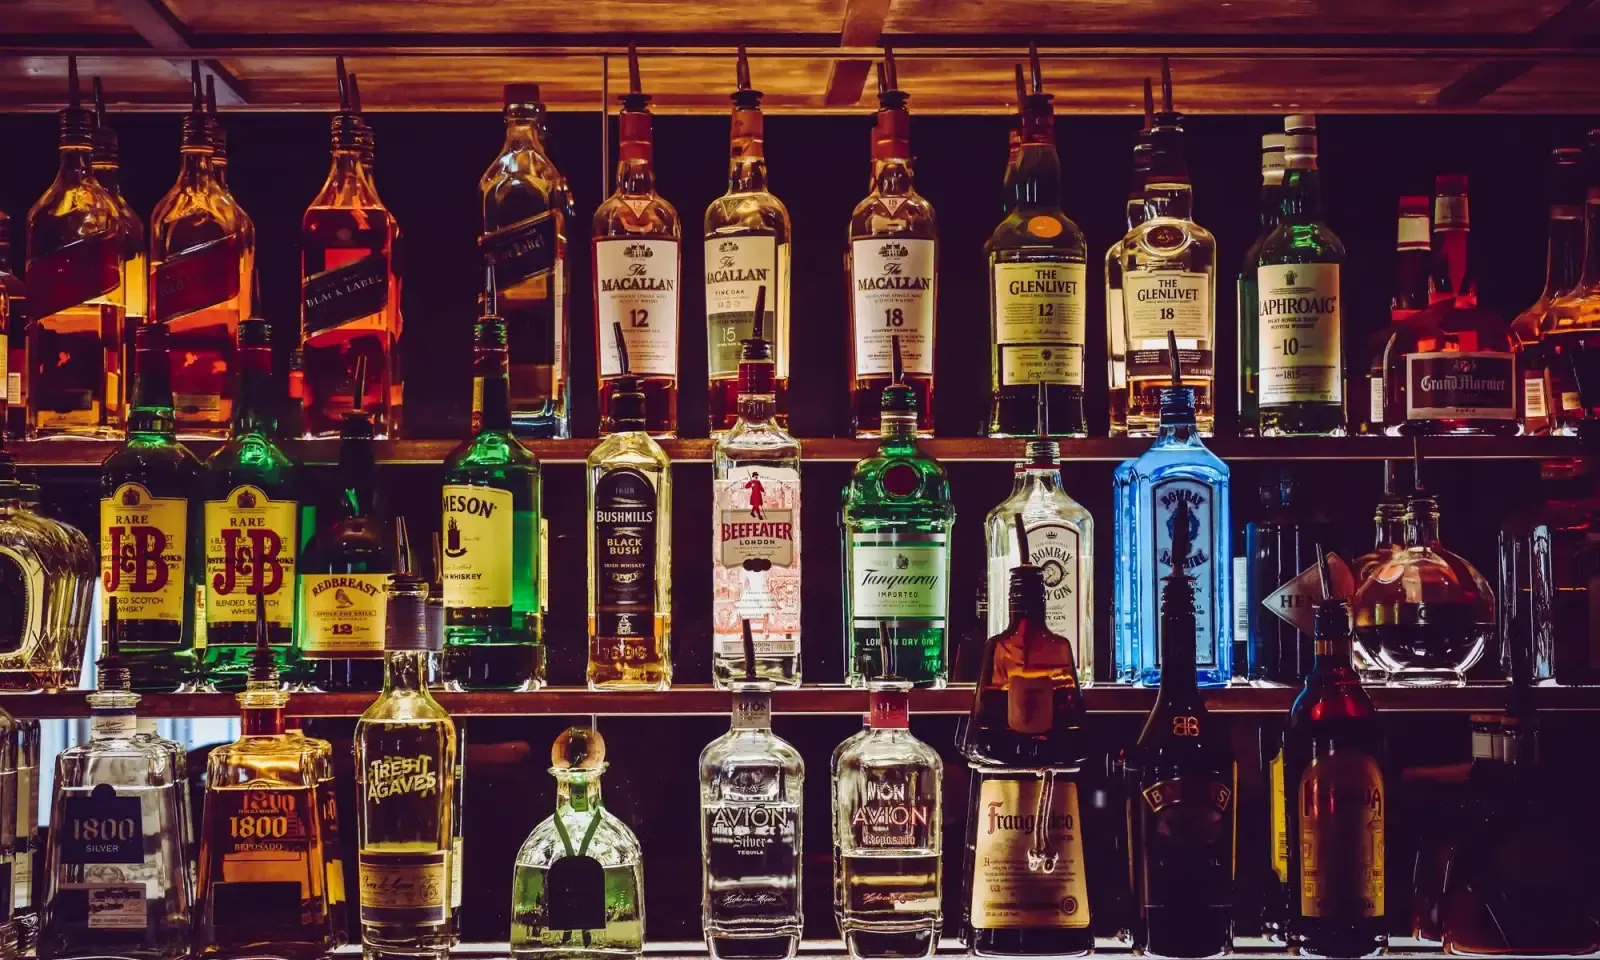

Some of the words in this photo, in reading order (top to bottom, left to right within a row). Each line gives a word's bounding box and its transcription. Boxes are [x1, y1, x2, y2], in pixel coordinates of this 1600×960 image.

[627, 263, 648, 276] The
[718, 256, 736, 269] The
[881, 262, 902, 275] The
[1035, 269, 1057, 280] THE
[306, 289, 343, 308] BLACK
[347, 273, 382, 292] LABEL
[601, 277, 674, 292] MACALLAN
[858, 277, 932, 291] MACALLAN
[1009, 280, 1077, 295] GLENLIVET
[1158, 279, 1178, 288] THE
[1137, 289, 1198, 301] GLENLIVET
[1038, 303, 1054, 316] 12
[1160, 308, 1175, 320] 18
[630, 309, 649, 328] 12
[885, 308, 904, 327] 18
[722, 327, 736, 342] 15
[1283, 337, 1299, 356] 10
[1421, 375, 1458, 391] Grand
[1460, 375, 1505, 391] Marnier
[1160, 489, 1205, 510] BOMBAY
[116, 515, 149, 525] RARE
[230, 517, 266, 527] RARE
[596, 511, 653, 523] BUSHMILLS
[721, 522, 793, 542] BEEFEATER
[607, 538, 642, 546] BLACK
[610, 546, 640, 555] BUSH
[1030, 547, 1073, 565] BOMBAY
[104, 526, 169, 593] J&B
[213, 528, 283, 595] J&B
[861, 568, 939, 589] Tanqueray
[312, 577, 378, 597] REDBREAST
[1053, 584, 1073, 601] GIN
[131, 596, 163, 604] SCOTCH
[332, 624, 352, 634] 12
[902, 638, 919, 646] DRY
[921, 638, 934, 646] GIN
[368, 771, 437, 804] AGAVES
[73, 818, 135, 841] 1800
[229, 816, 287, 838] 1800
[733, 835, 766, 848] Silver
